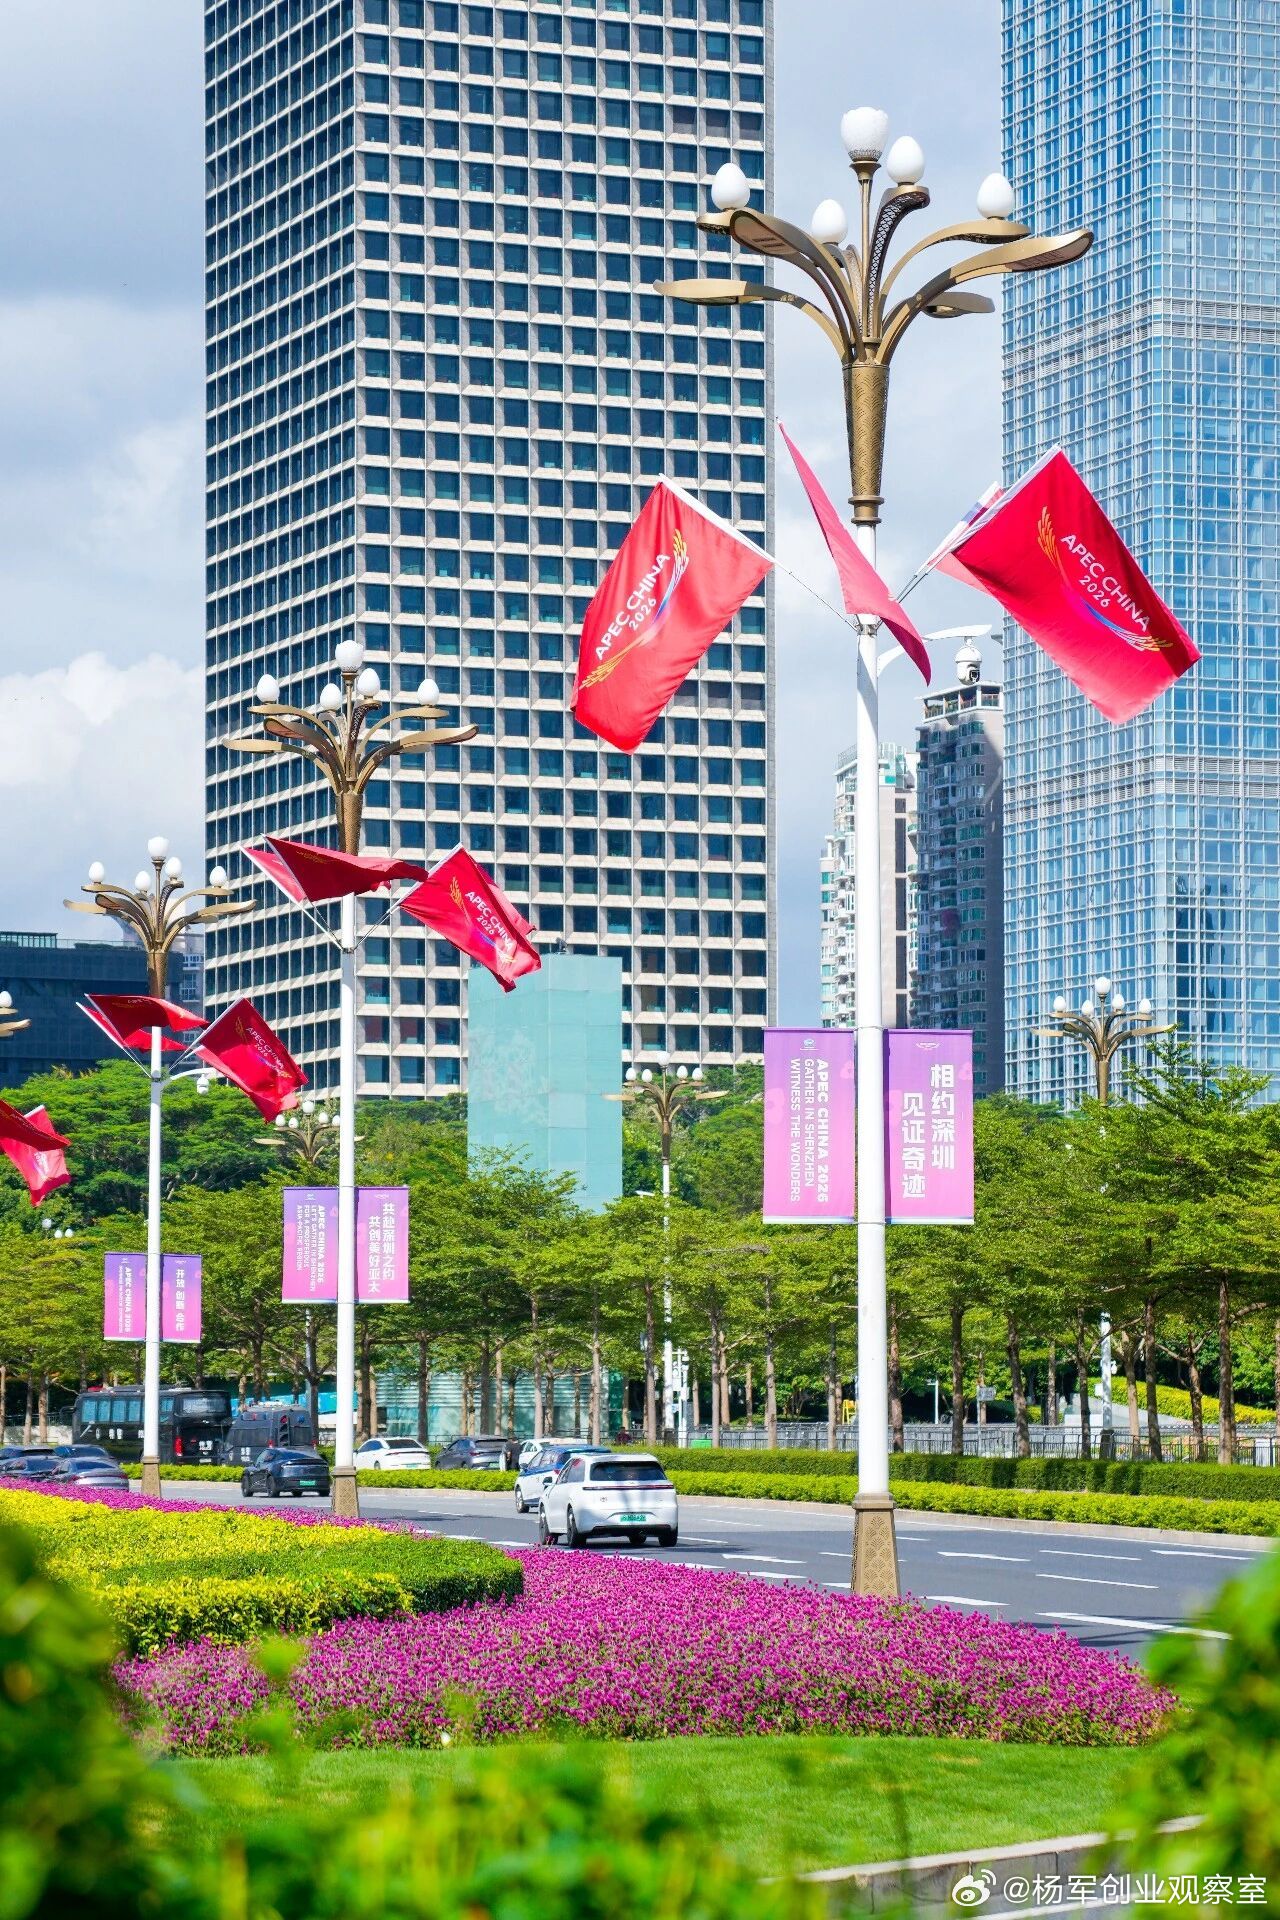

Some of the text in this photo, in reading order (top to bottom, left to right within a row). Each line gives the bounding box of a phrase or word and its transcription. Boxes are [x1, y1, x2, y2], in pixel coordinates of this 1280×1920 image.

[595, 554, 670, 660] APEC CHINA
[629, 598, 656, 631] 2026
[1061, 534, 1150, 632] APEC CHINA
[1079, 575, 1111, 608] 2026
[465, 892, 513, 950] APEC CHINA
[476, 915, 495, 934] 2026
[246, 1027, 284, 1068] APEC CHINA
[255, 1043, 268, 1057] 2026
[805, 1058, 815, 1104] GATHER
[790, 1058, 801, 1202] WITNESS THE WONDERS
[805, 1107, 815, 1120] IN
[817, 1058, 829, 1203] APEC CHINA 2026
[902, 1093, 926, 1198] 见证奇迹
[931, 1064, 955, 1170] 相约深圳
[805, 1123, 815, 1187] SHENZHEN
[317, 1205, 326, 1284] APEC CHINA 2026
[368, 1216, 381, 1294] 共创美好亚太
[382, 1203, 395, 1281] 共赴深圳之约
